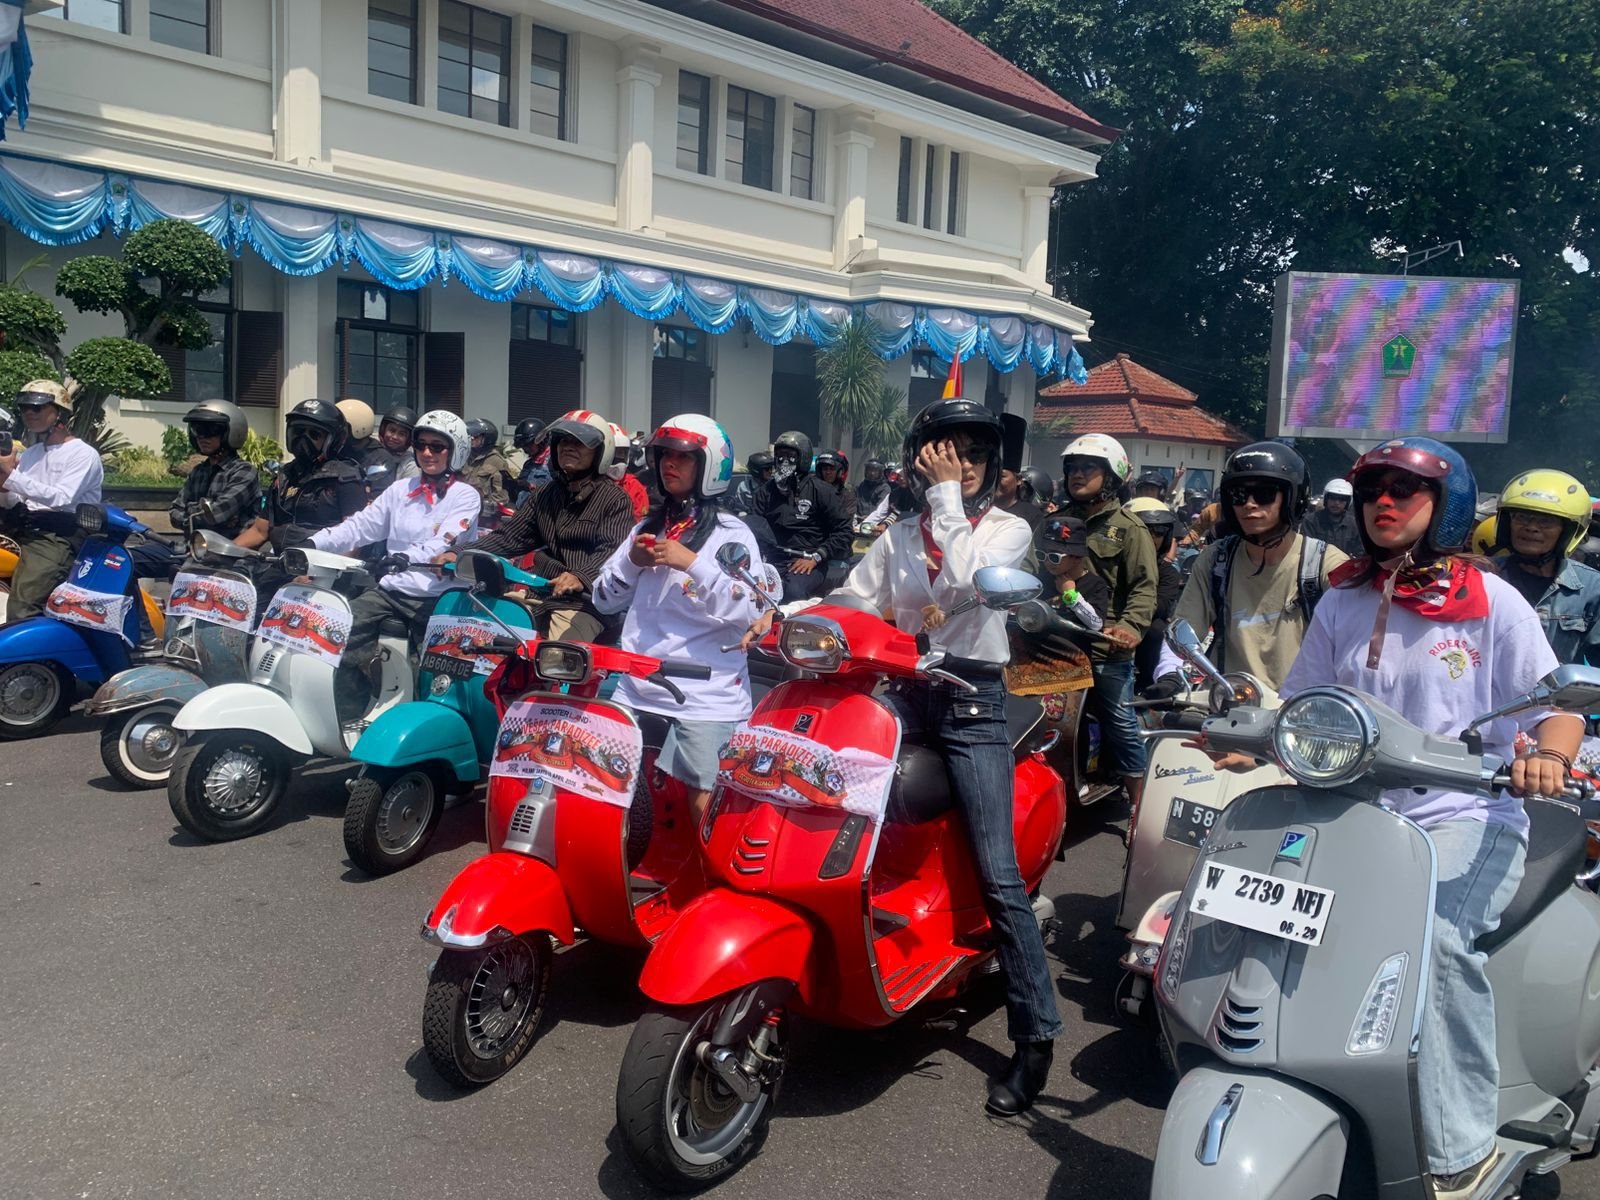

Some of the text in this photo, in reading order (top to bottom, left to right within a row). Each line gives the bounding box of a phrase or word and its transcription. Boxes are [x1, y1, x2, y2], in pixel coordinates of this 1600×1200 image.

[522, 719, 602, 750] VESPA PARADIZEE
[760, 735, 818, 768] PARADIZEE
[1172, 800, 1221, 827] N 58
[1206, 866, 1326, 919] W 2739 NFJ
